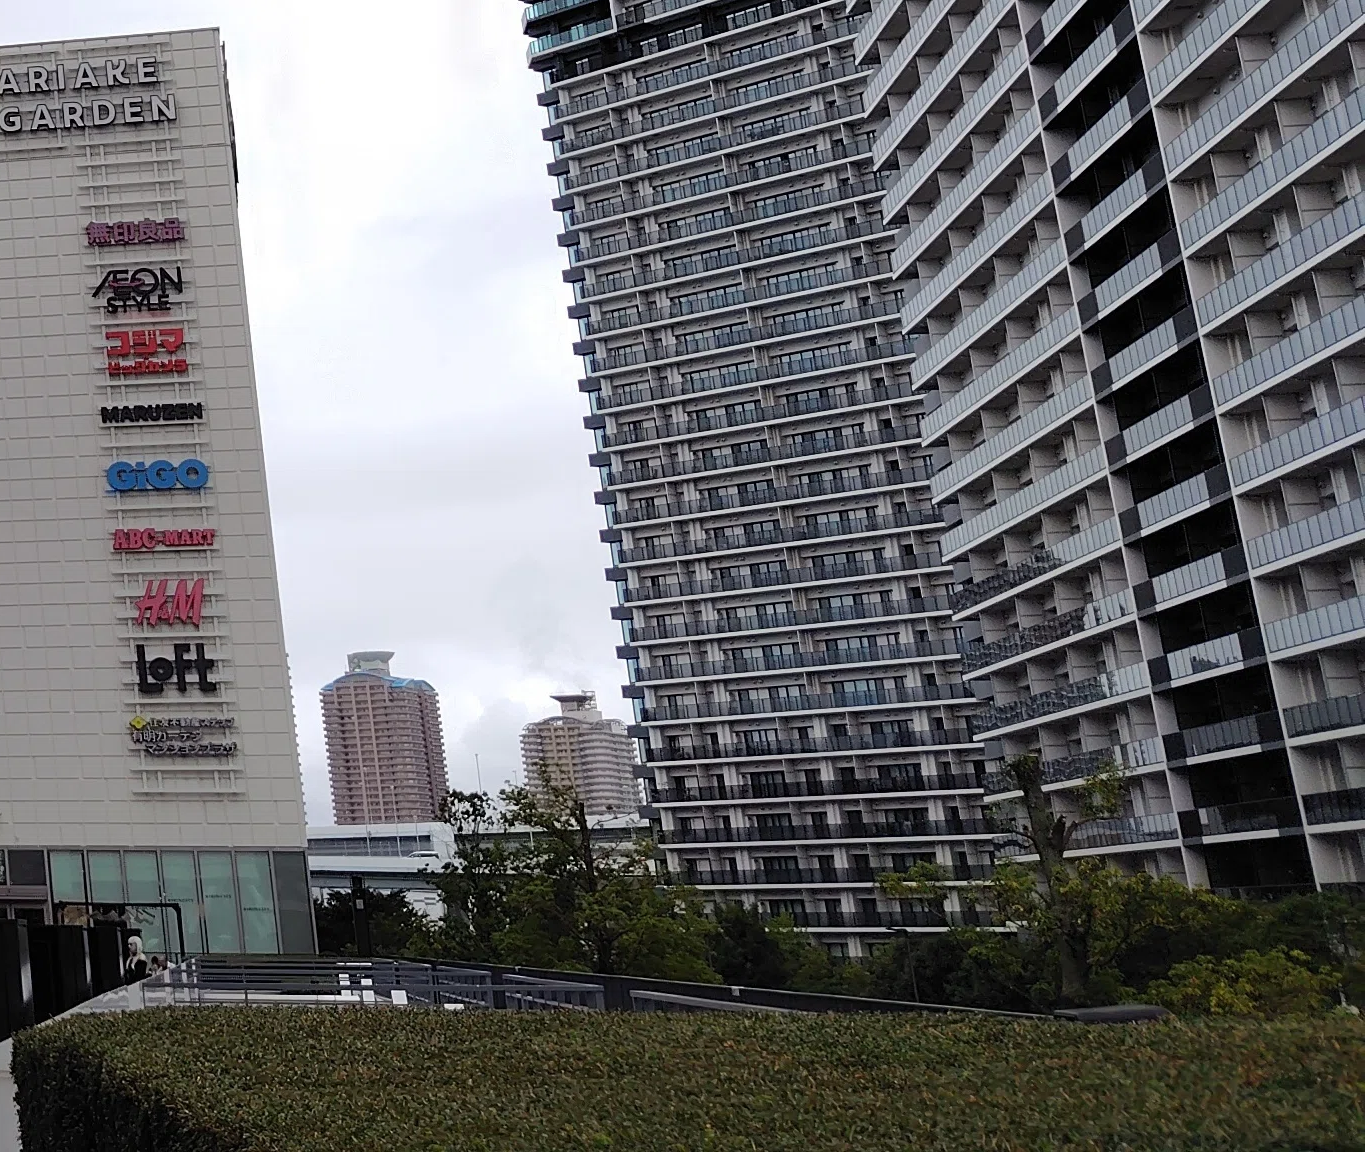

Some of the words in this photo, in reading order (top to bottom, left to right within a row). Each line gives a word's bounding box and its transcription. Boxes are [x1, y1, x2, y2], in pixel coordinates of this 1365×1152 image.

[87, 217, 185, 247] 無印良品
[107, 294, 171, 314] STYLE
[106, 328, 184, 356] コジマ
[101, 403, 203, 424] MARUZEN
[113, 528, 215, 550] ABC-MART
[135, 578, 205, 626] H&M
